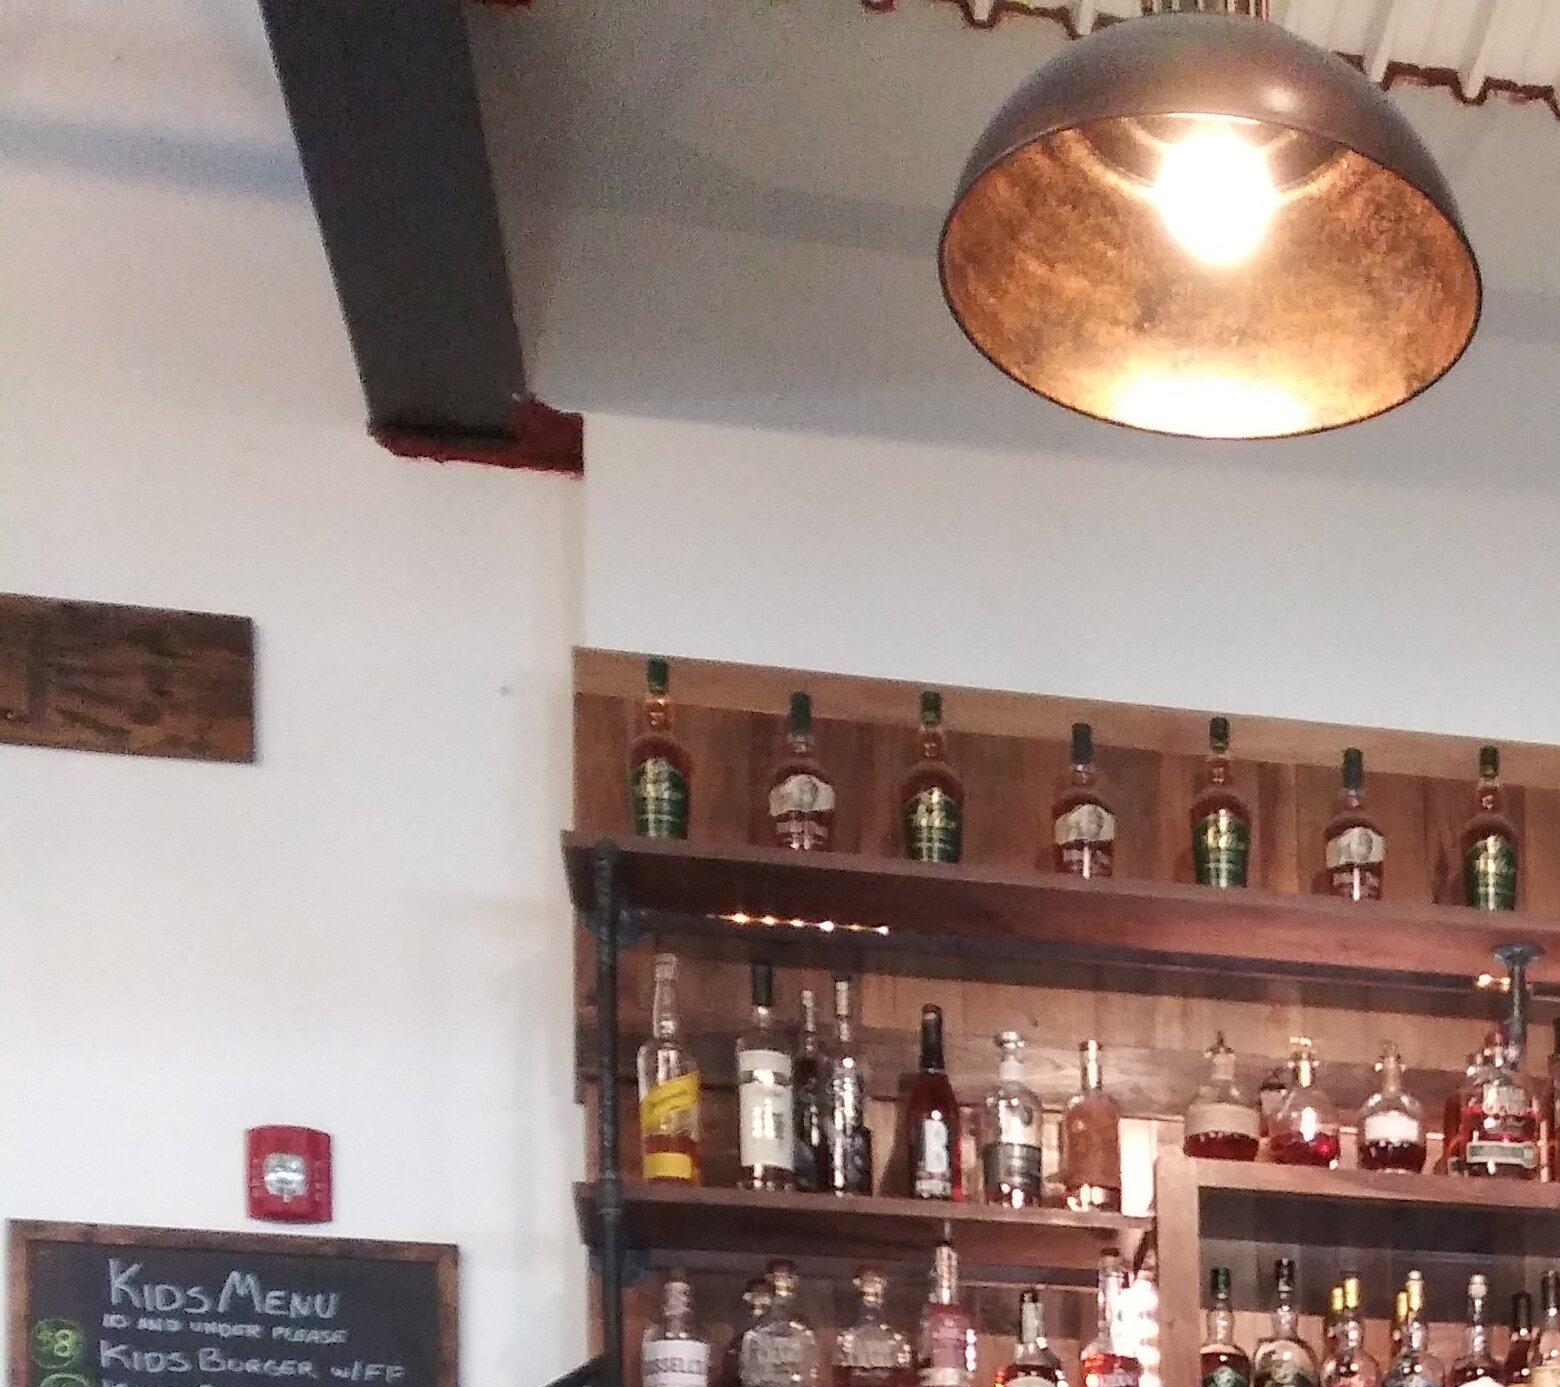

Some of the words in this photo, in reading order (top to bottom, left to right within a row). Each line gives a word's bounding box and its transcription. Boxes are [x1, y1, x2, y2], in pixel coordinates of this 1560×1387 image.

[108, 1258, 212, 1314] KIDS
[217, 1270, 339, 1319] MENU
[100, 1339, 193, 1374] KIDS
[199, 1347, 320, 1380] BURGER
